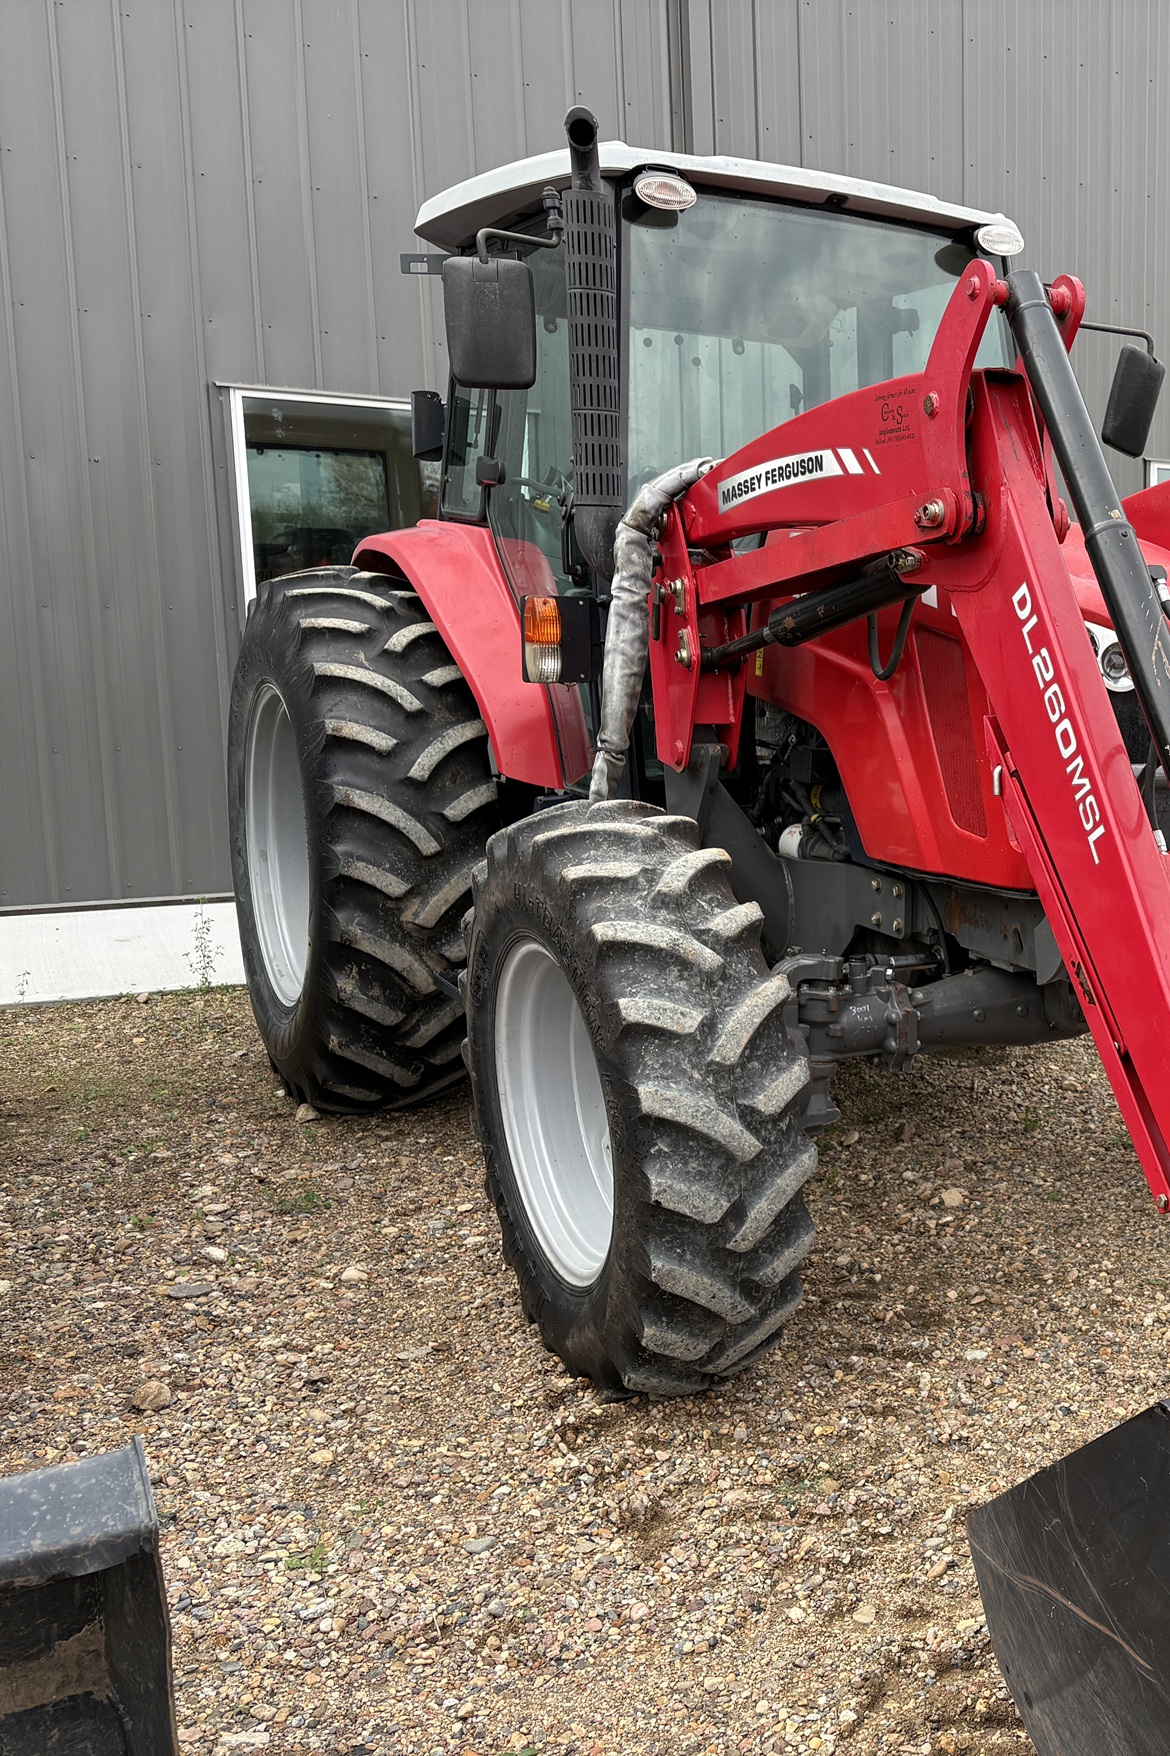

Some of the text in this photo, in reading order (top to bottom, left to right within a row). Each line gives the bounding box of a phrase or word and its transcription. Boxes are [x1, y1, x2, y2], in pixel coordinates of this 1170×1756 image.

[722, 454, 824, 506] MASSEY FERGUSON
[1011, 580, 1106, 866] DL260MSL
[850, 1004, 870, 1016] 3001
